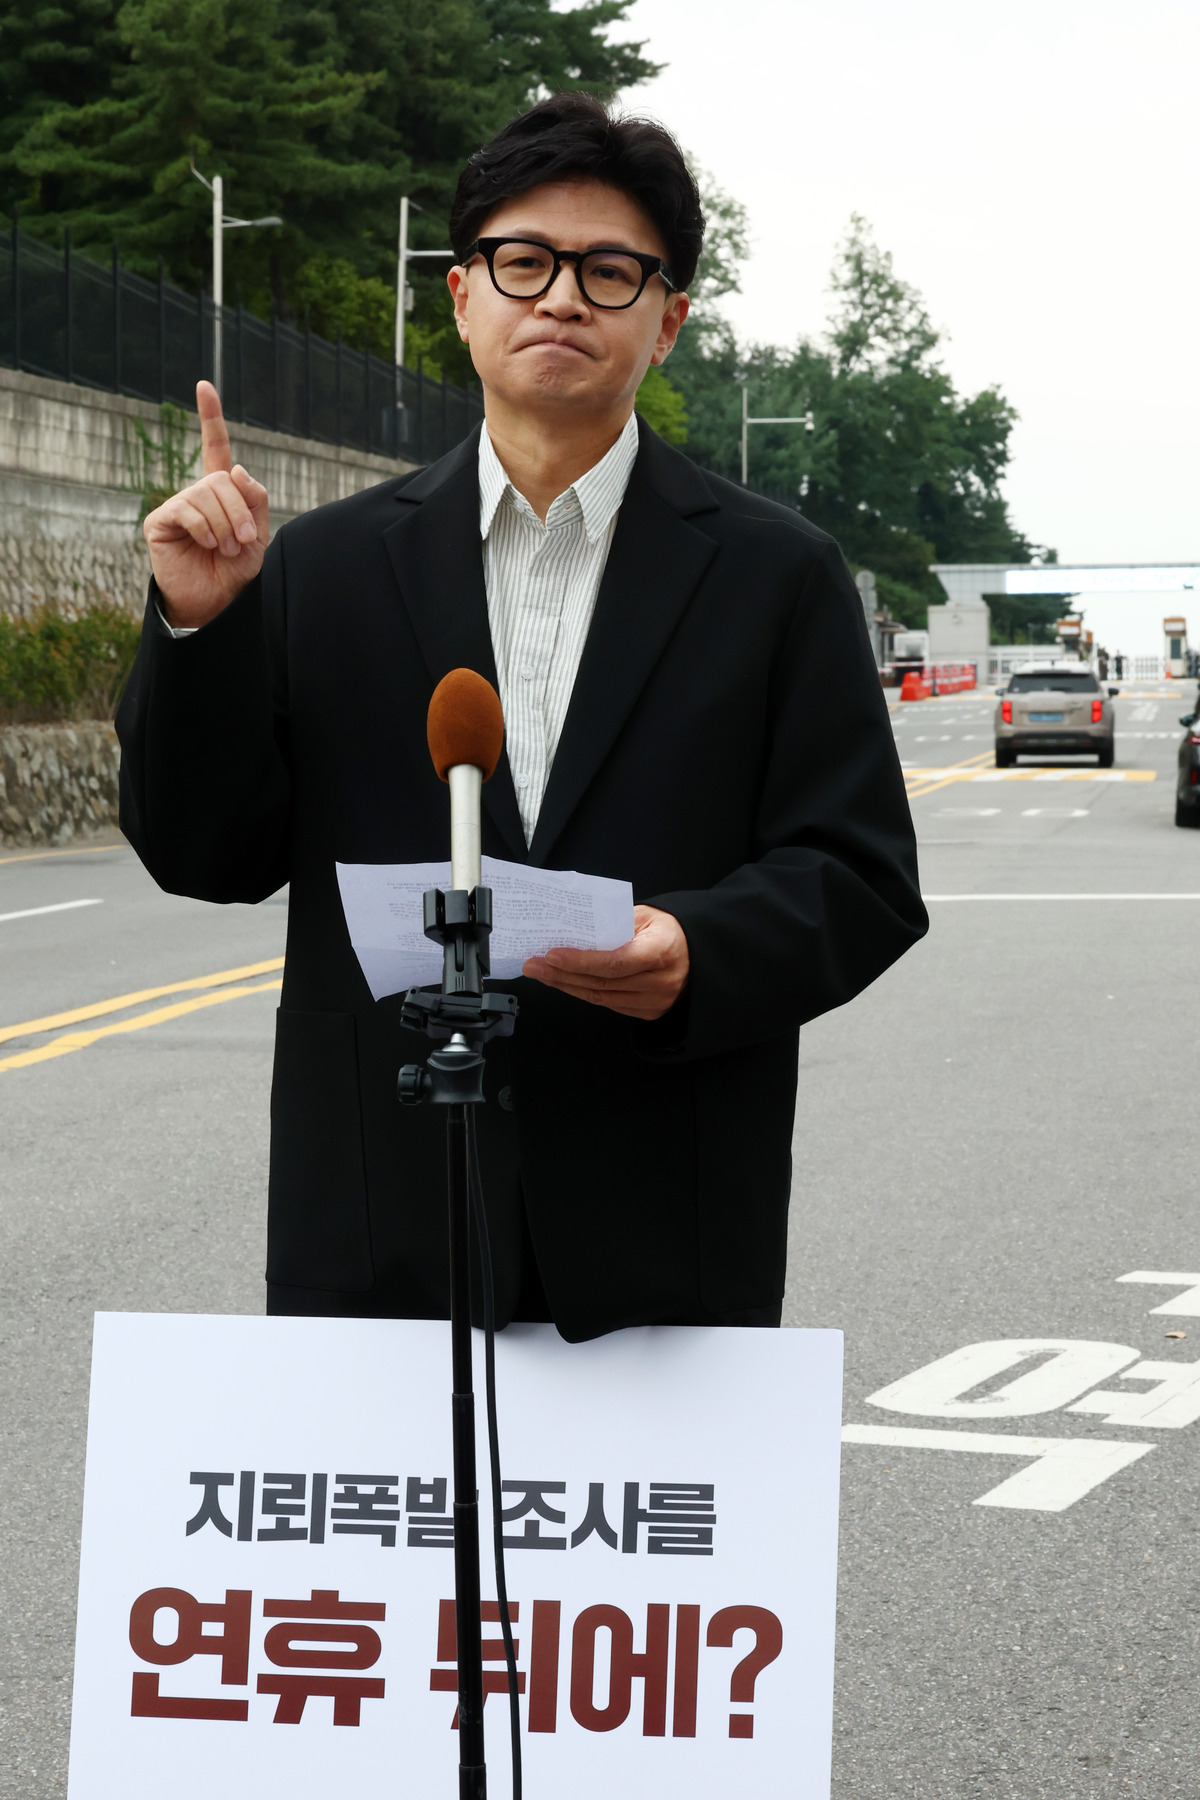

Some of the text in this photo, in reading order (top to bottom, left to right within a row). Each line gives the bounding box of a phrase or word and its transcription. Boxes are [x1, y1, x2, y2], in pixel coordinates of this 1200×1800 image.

[501, 1479, 717, 1556] 조사를
[128, 1587, 784, 1739] 연휴 뒤에?
